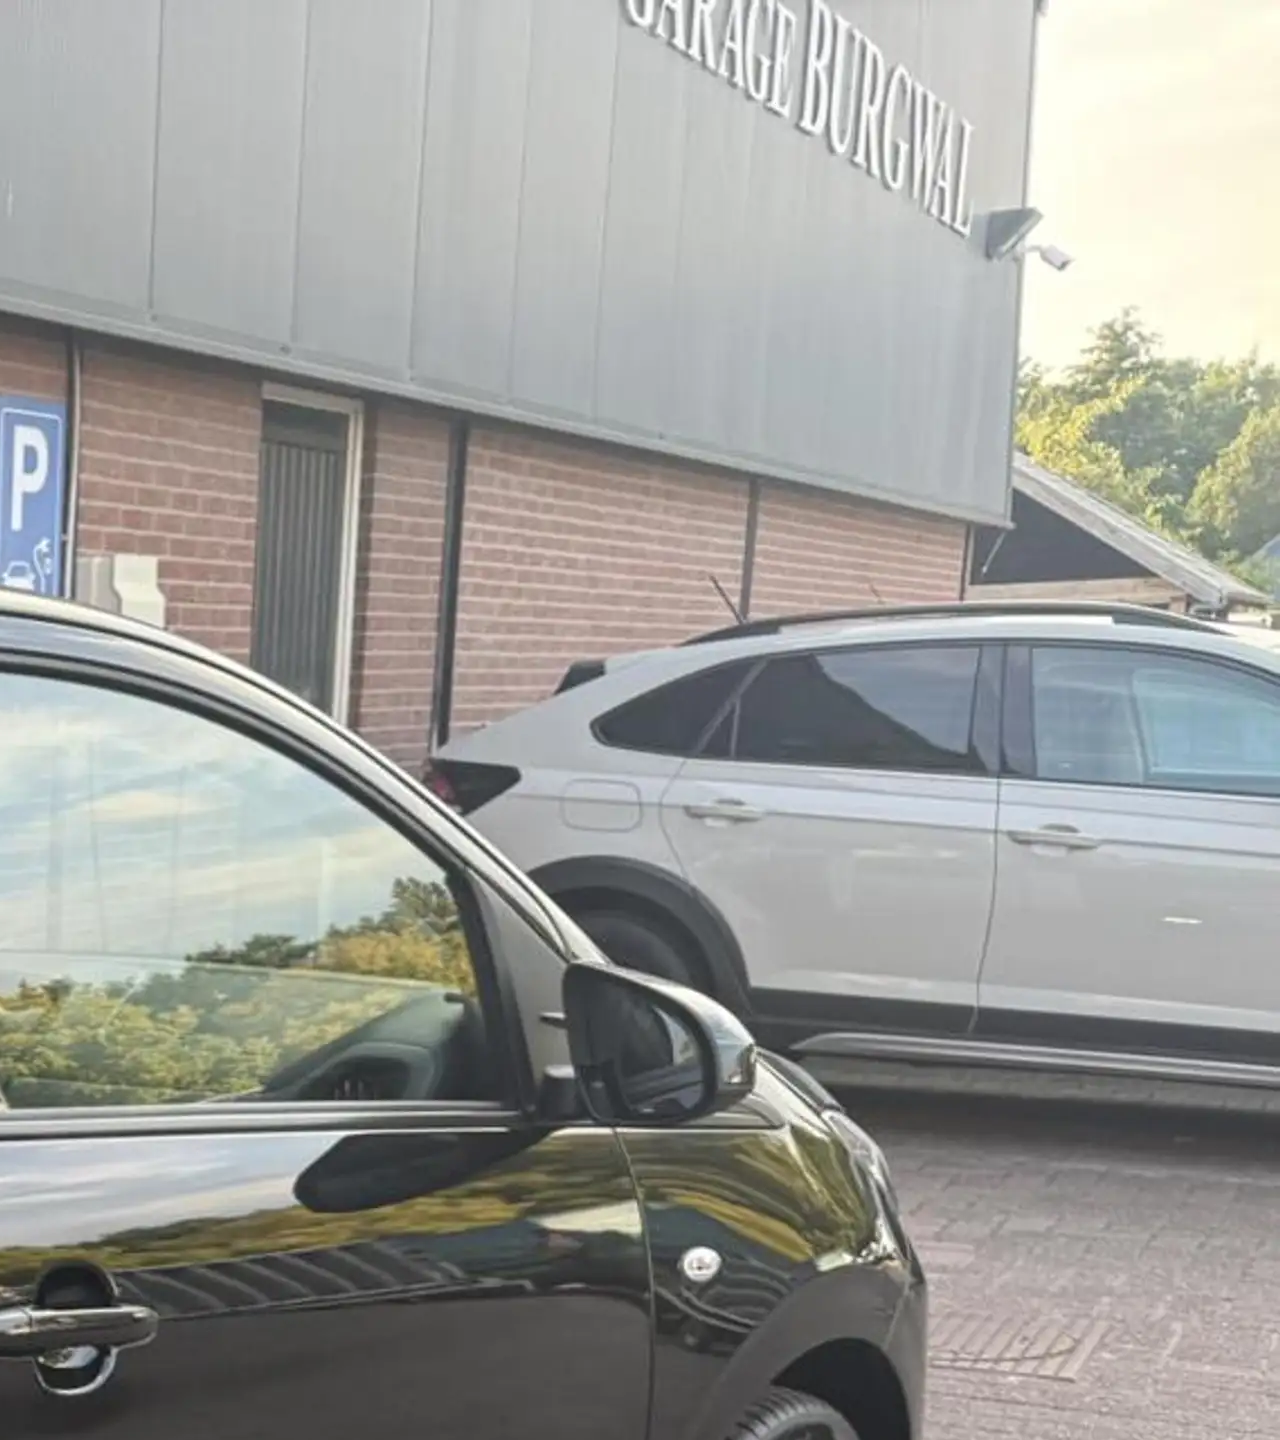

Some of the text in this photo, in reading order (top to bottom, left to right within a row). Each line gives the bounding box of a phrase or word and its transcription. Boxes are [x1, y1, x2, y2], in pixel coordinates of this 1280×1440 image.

[627, 0, 975, 238] ARAGE BURGWAL
[11, 424, 48, 530] P
